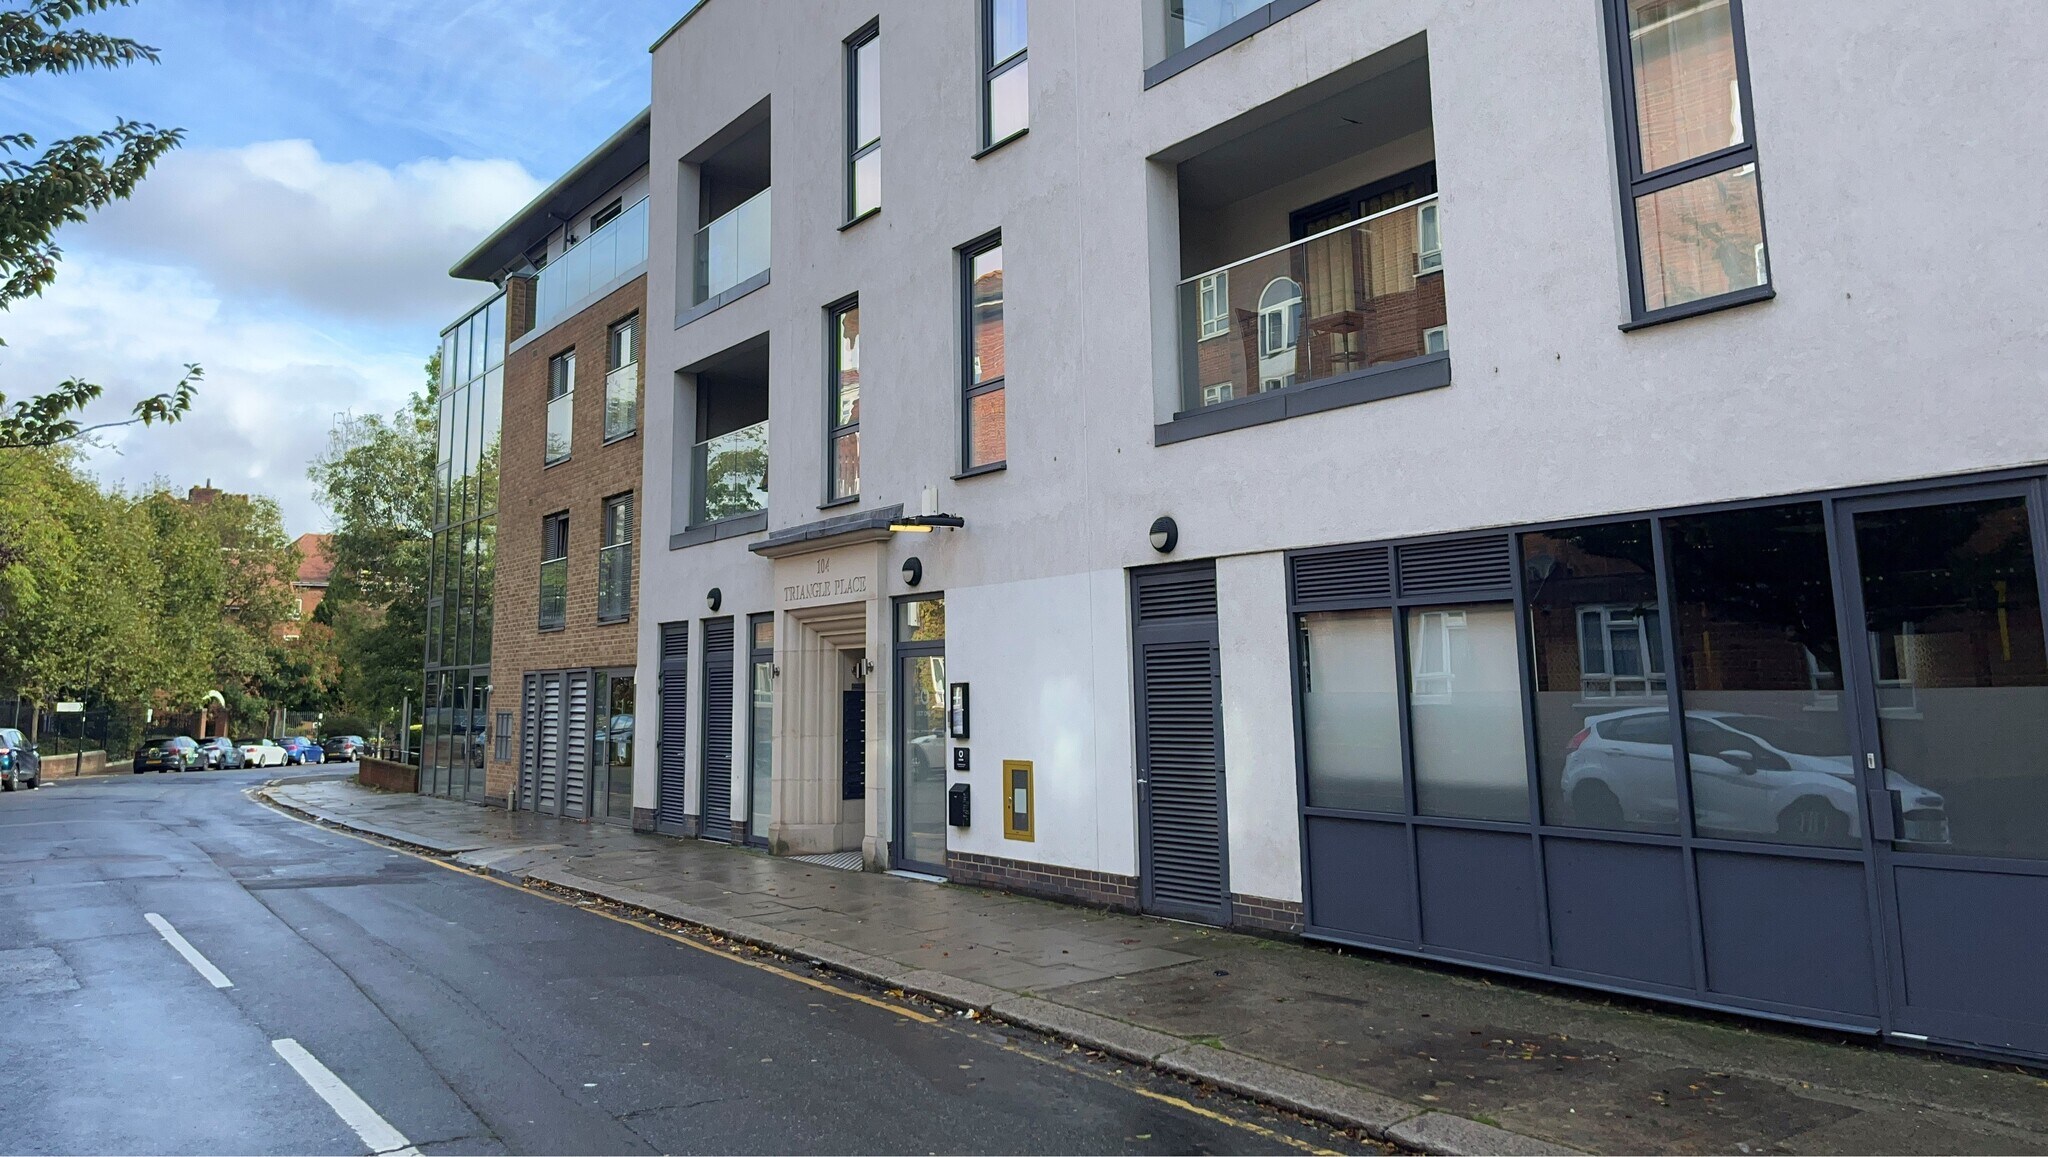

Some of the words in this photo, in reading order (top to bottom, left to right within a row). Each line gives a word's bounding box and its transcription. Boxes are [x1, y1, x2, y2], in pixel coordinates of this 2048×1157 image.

[817, 557, 830, 574] 104
[784, 581, 831, 602] TRIANGLE
[834, 576, 867, 596] PLACE
